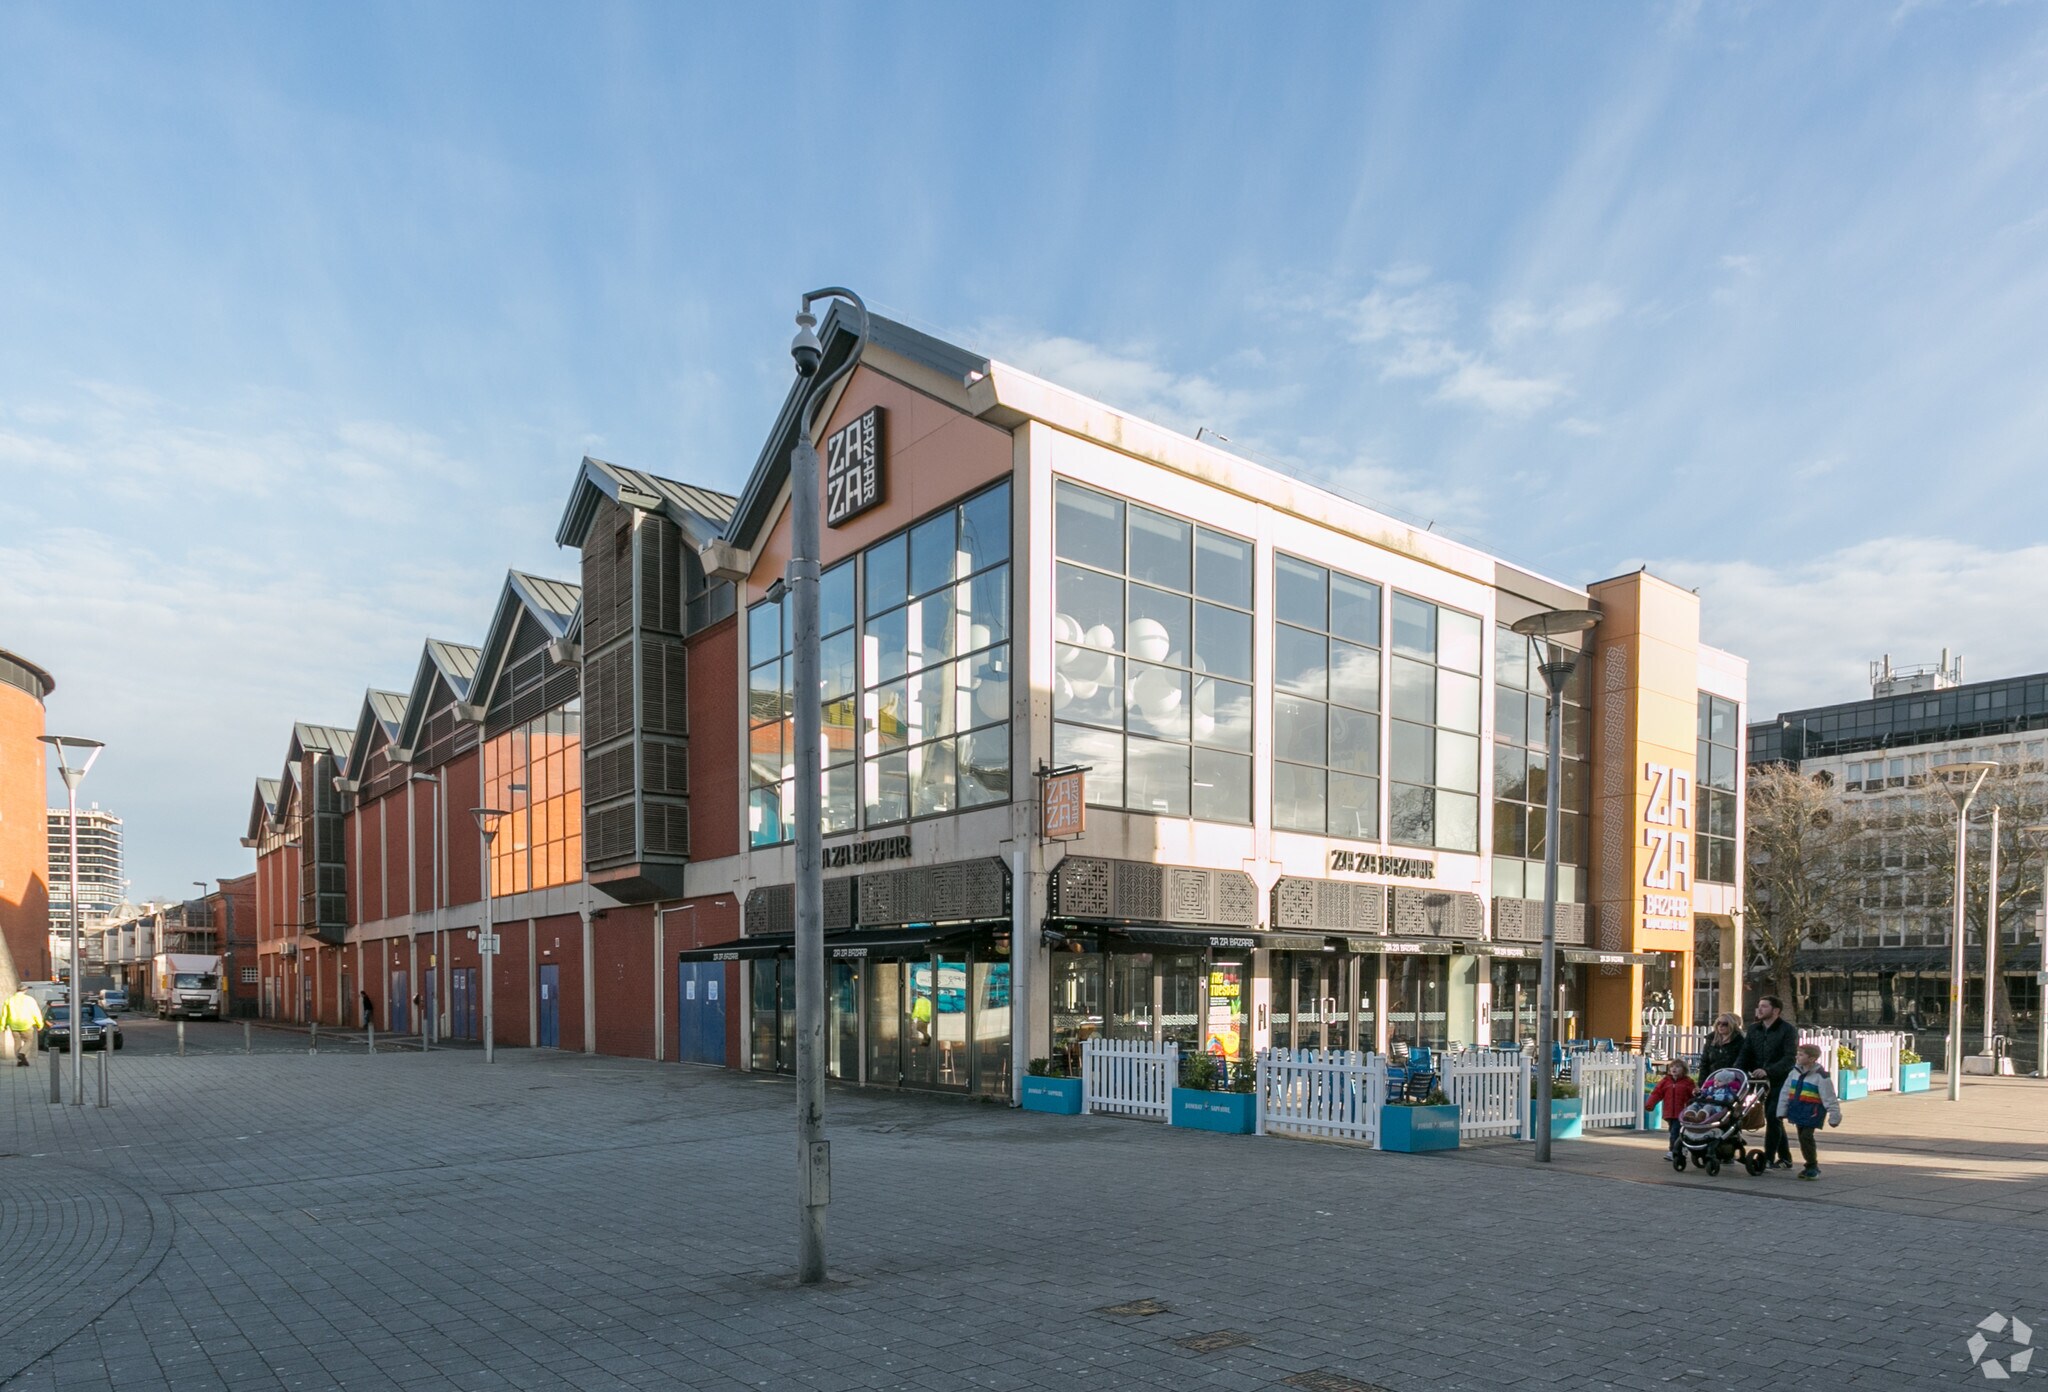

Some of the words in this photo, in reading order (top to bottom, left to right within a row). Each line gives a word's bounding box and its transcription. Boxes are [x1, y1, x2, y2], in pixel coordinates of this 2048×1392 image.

[828, 419, 862, 479] ZA
[863, 410, 875, 504] BAZAAR
[828, 466, 862, 522] ZA
[1047, 779, 1071, 805] ZA
[1071, 777, 1079, 825] BAZAAR
[1644, 761, 1691, 829] ZA
[1047, 803, 1071, 829] ZA
[822, 848, 830, 869] A
[831, 844, 851, 867] ZA
[852, 835, 912, 865] BAZAAR
[1331, 849, 1354, 871] ZA
[1355, 852, 1377, 874] ZA
[1378, 855, 1435, 879] BAZAAR
[1643, 827, 1690, 892] ZA
[1643, 894, 1689, 918] BAZAAR
[832, 949, 841, 957] ZA
[841, 949, 848, 957] ZA
[848, 948, 868, 956] BAZAAR
[1209, 937, 1219, 946] ZA
[1219, 937, 1229, 946] ZA
[1229, 937, 1254, 947] BAZAAR
